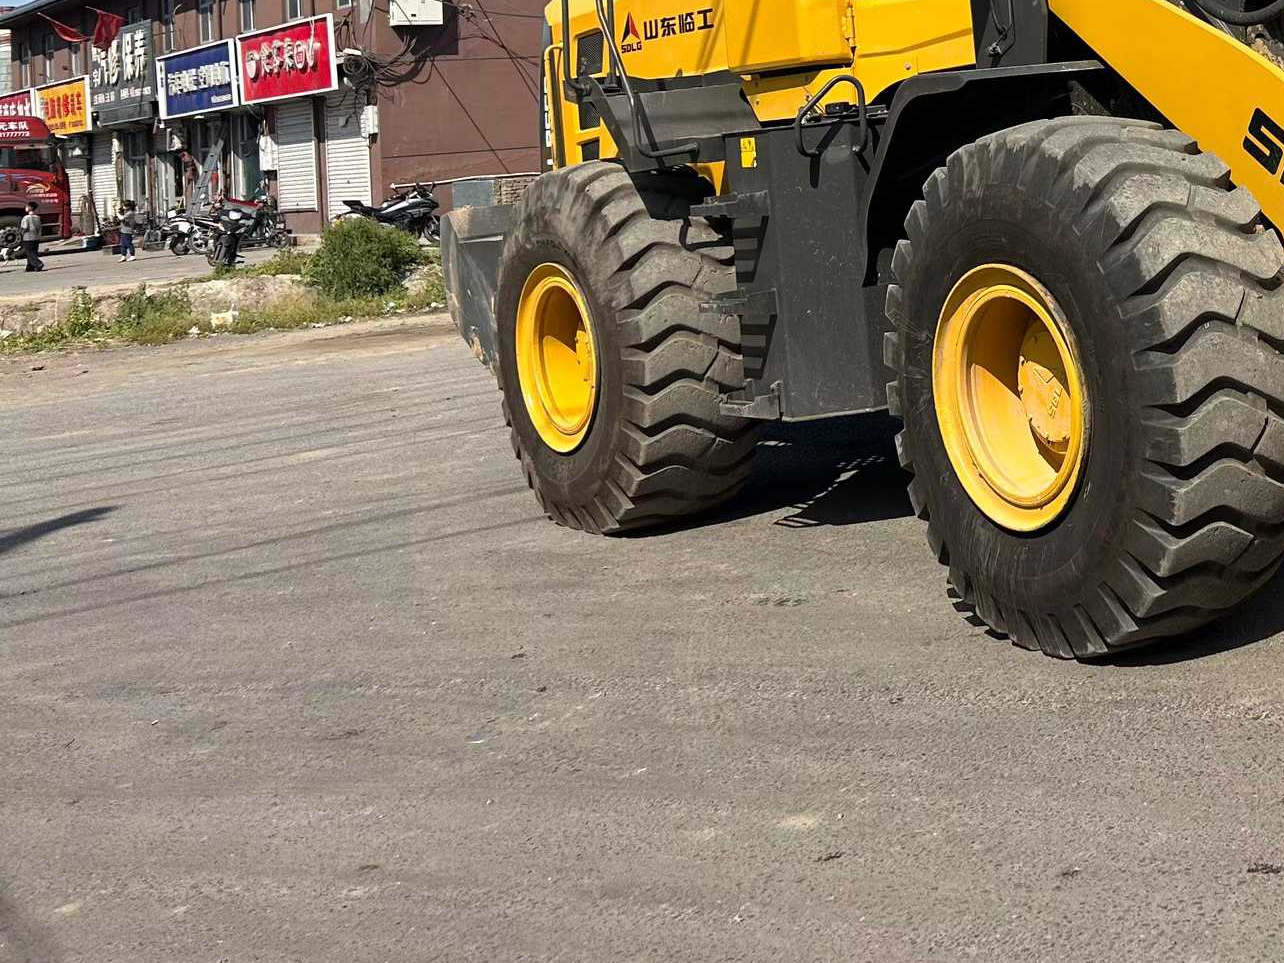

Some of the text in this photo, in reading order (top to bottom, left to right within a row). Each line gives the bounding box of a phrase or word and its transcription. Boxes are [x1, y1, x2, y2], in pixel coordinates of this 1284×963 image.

[643, 8, 715, 41] 山东临工
[621, 41, 643, 54] SDLG
